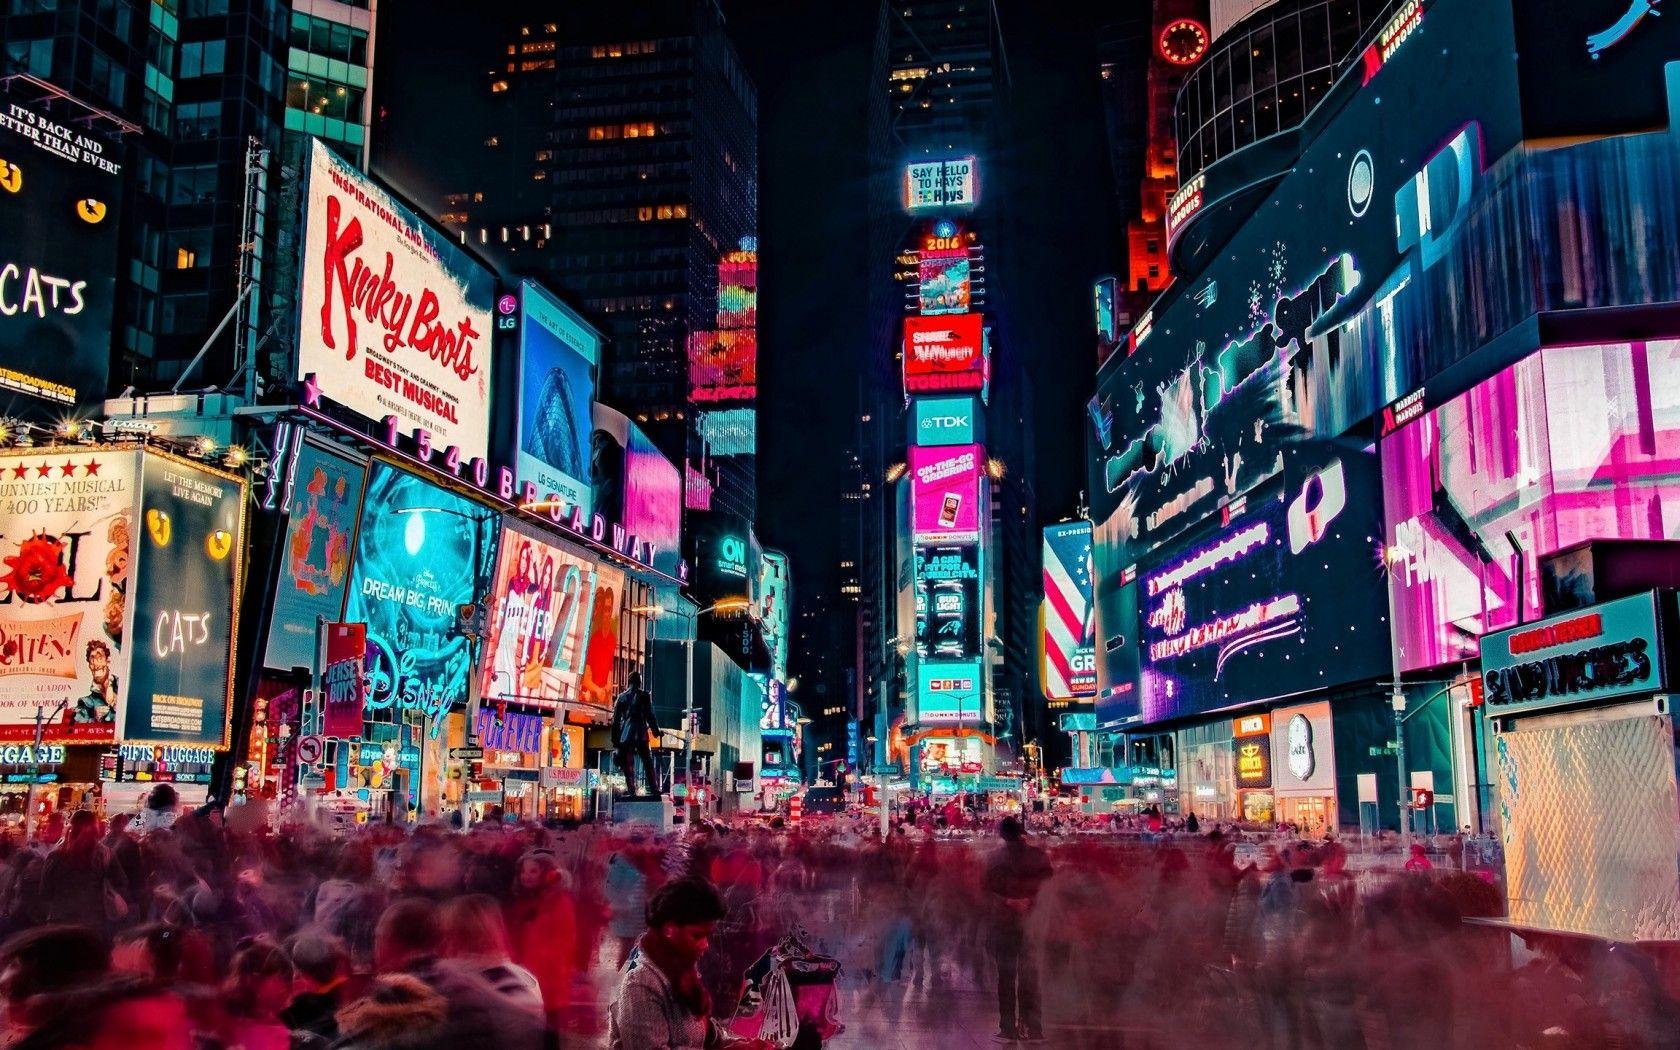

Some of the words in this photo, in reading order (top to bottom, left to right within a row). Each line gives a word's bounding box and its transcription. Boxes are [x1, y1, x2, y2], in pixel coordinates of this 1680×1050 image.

[1382, 0, 1424, 46] MARRIOT
[1383, 12, 1421, 63] MARQUIS
[10, 103, 36, 125] IT'S
[38, 116, 73, 141] BACK
[75, 134, 103, 154] AND
[43, 132, 80, 158] THAN
[912, 167, 932, 178] SAY
[918, 179, 931, 188] TO
[1170, 174, 1205, 217] MARRIOTT
[1171, 195, 1200, 230] MARQUIS
[405, 226, 422, 246] AND
[927, 238, 959, 250] 2016
[920, 250, 967, 259] TOSHIBA
[0, 263, 87, 318] CATS
[320, 194, 411, 361] Kinky
[407, 287, 479, 381] Boots
[499, 318, 516, 330] LG
[364, 356, 401, 393] BEST
[402, 378, 459, 425] MUSICAL
[907, 372, 983, 390] TOSHIBA
[1395, 386, 1425, 413] MARRIOTT
[931, 416, 968, 428] TDK
[1396, 401, 1423, 424] MARQUIS
[917, 453, 974, 477] ON-THE-GO
[921, 461, 974, 484] ORDERING
[63, 478, 125, 494] MUSICAL
[164, 471, 177, 483] LET
[179, 476, 192, 488] THE
[193, 480, 223, 498] MEMORY
[381, 414, 488, 487] 1540
[500, 466, 658, 567] BROADWAY
[538, 471, 546, 485] LG
[546, 474, 577, 501] SIGNATURE
[7, 500, 38, 514] 400
[172, 486, 189, 499] LIVE
[190, 492, 213, 506] AGAIN
[722, 538, 745, 565] ON
[932, 556, 940, 564] A
[940, 556, 961, 564] CAN
[718, 560, 735, 569] smart
[940, 563, 961, 572] FOR
[961, 562, 970, 571] A
[363, 577, 405, 604] DREAM
[406, 589, 426, 612] BIG,
[938, 595, 959, 603] BUD
[936, 602, 961, 611] LIGHT
[553, 565, 598, 675] 21
[155, 610, 210, 657] CATS
[1070, 655, 1095, 671] GR
[330, 681, 356, 702] BOYS
[20, 700, 28, 708] OF
[477, 707, 542, 754] FOREVER
[0, 745, 64, 763] GAGE
[120, 745, 154, 761] GIFTS
[163, 746, 215, 764] LUGGAGE
